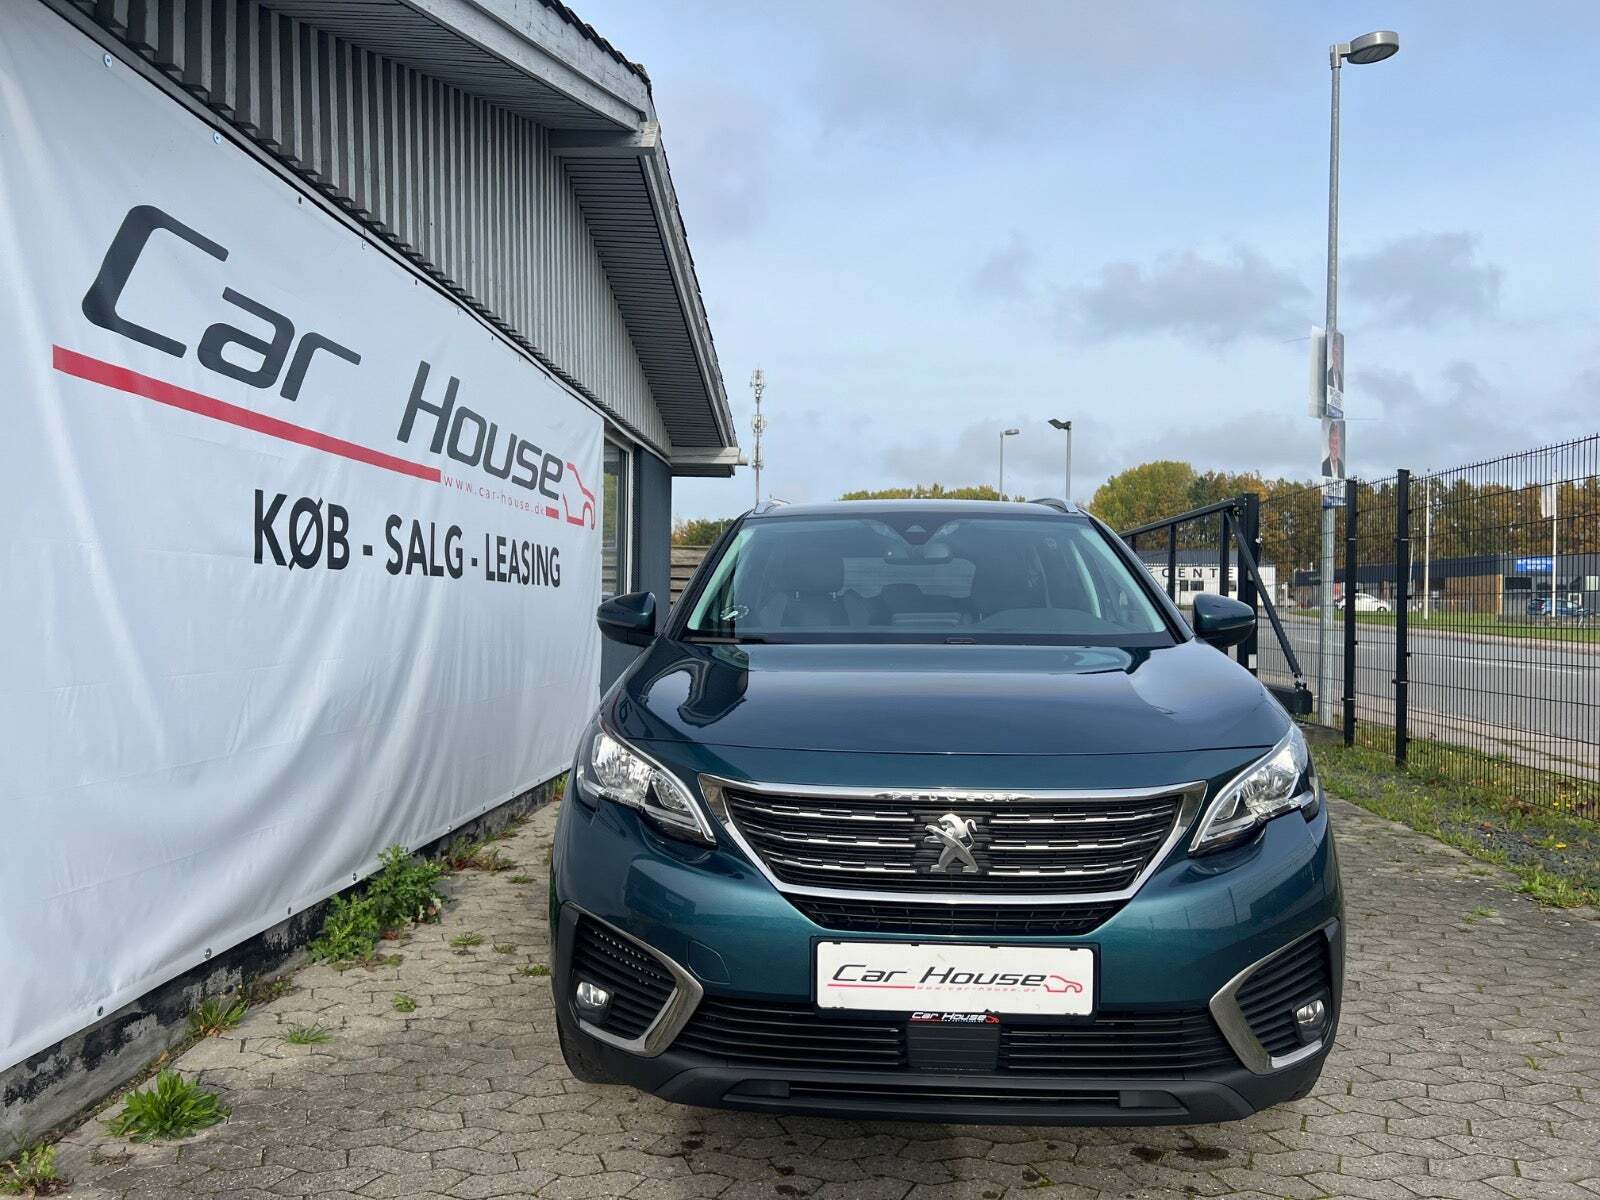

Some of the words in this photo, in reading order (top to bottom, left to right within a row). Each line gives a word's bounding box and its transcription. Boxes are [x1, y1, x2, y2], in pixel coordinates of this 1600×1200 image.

[81, 204, 361, 402] Car
[396, 359, 564, 501] House
[253, 488, 351, 572] KØB
[384, 513, 464, 580] SALG
[485, 532, 561, 588] LEASING
[831, 964, 908, 983] Car
[920, 966, 1047, 986] House
[911, 1011, 939, 1020] Car
[941, 1012, 987, 1022] House
